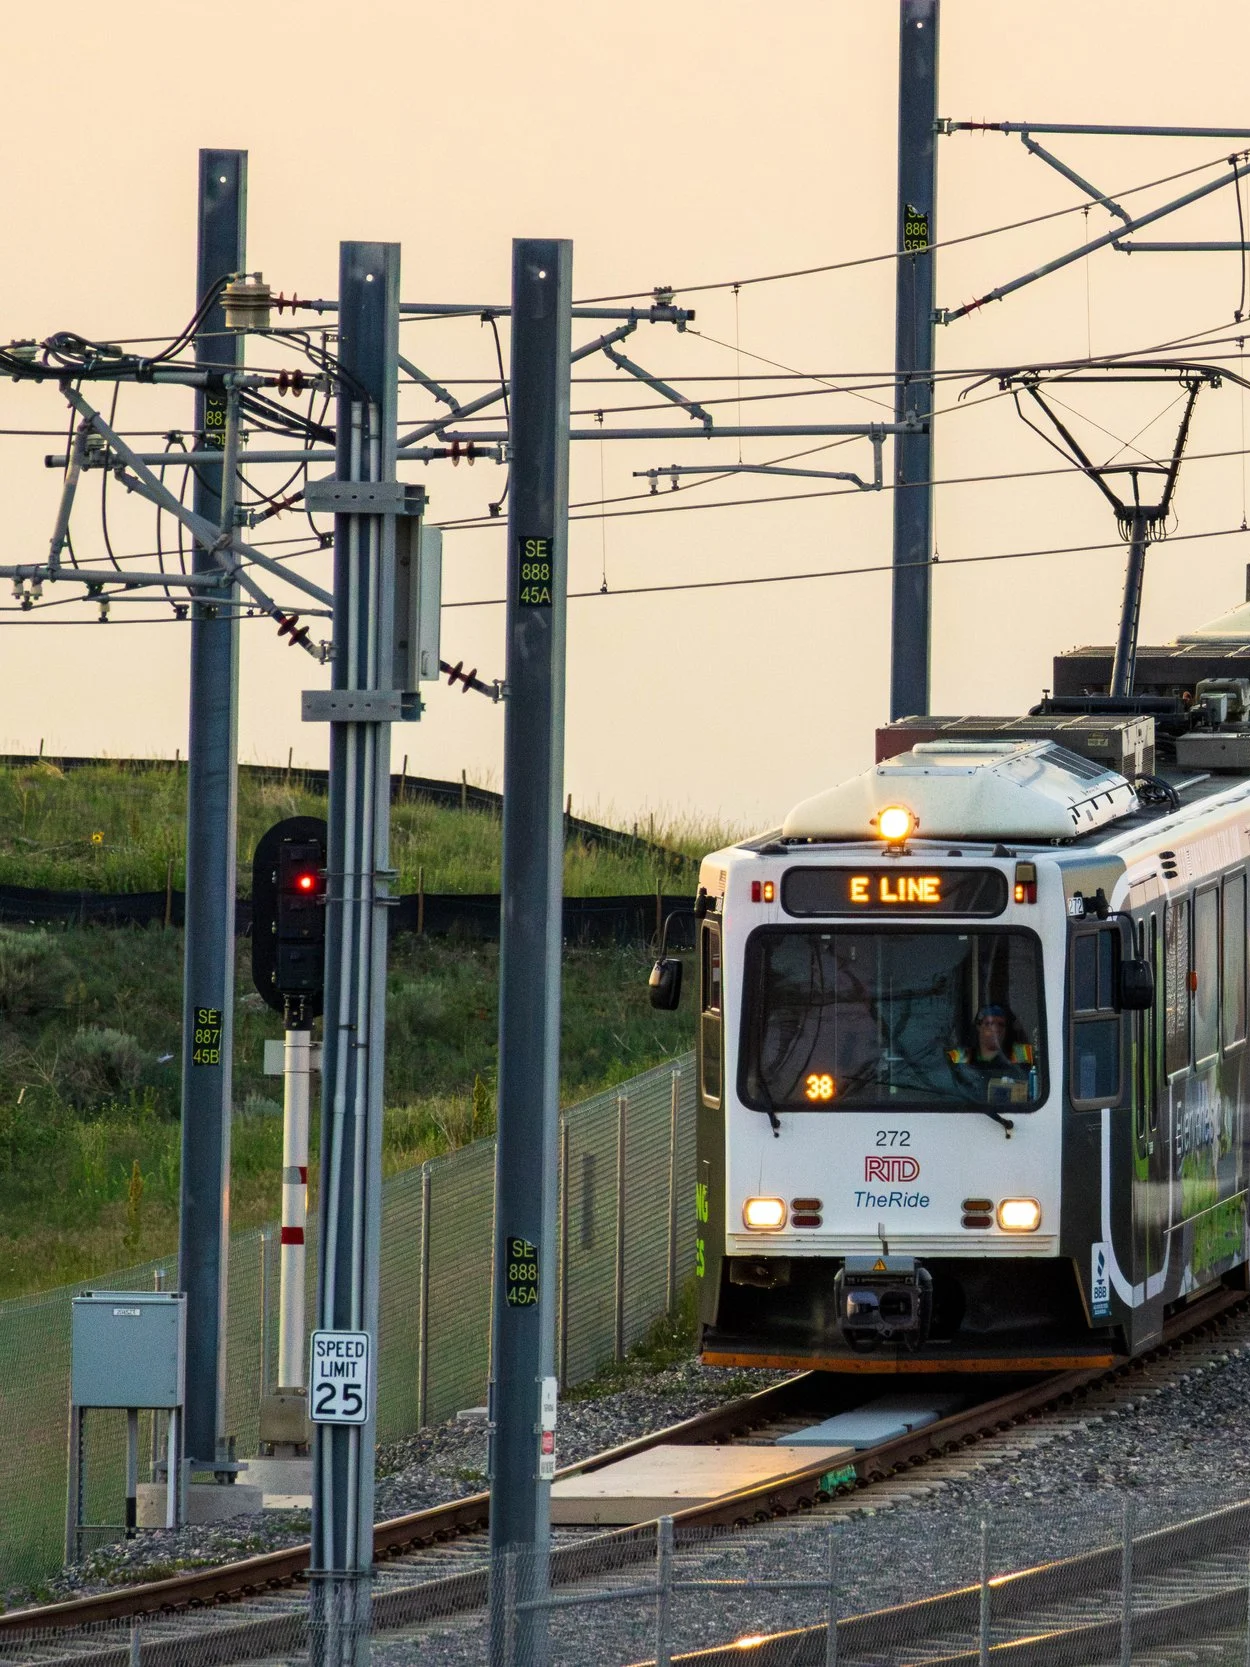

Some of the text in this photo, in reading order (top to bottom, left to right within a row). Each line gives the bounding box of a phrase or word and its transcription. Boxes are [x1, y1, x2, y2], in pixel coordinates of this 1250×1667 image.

[905, 222, 927, 235] 886
[206, 411, 227, 426] 88
[525, 540, 547, 557] SE
[522, 563, 550, 580] 888
[520, 586, 551, 603] 45A
[851, 877, 941, 902] E LINE
[198, 1009, 217, 1024] SE
[195, 1029, 220, 1044] 887
[193, 1049, 219, 1064] 45B
[805, 1074, 835, 1100] 38
[876, 1130, 911, 1147] 272
[864, 1155, 920, 1182] RTD
[854, 1191, 930, 1208] TheRide
[512, 1240, 534, 1257] SE
[509, 1263, 537, 1281] 888
[508, 1286, 538, 1304] 45A
[1094, 1286, 1107, 1299] BBB
[316, 1341, 365, 1358] SPEED
[320, 1361, 358, 1378] LIMIT
[315, 1382, 363, 1416] 25
